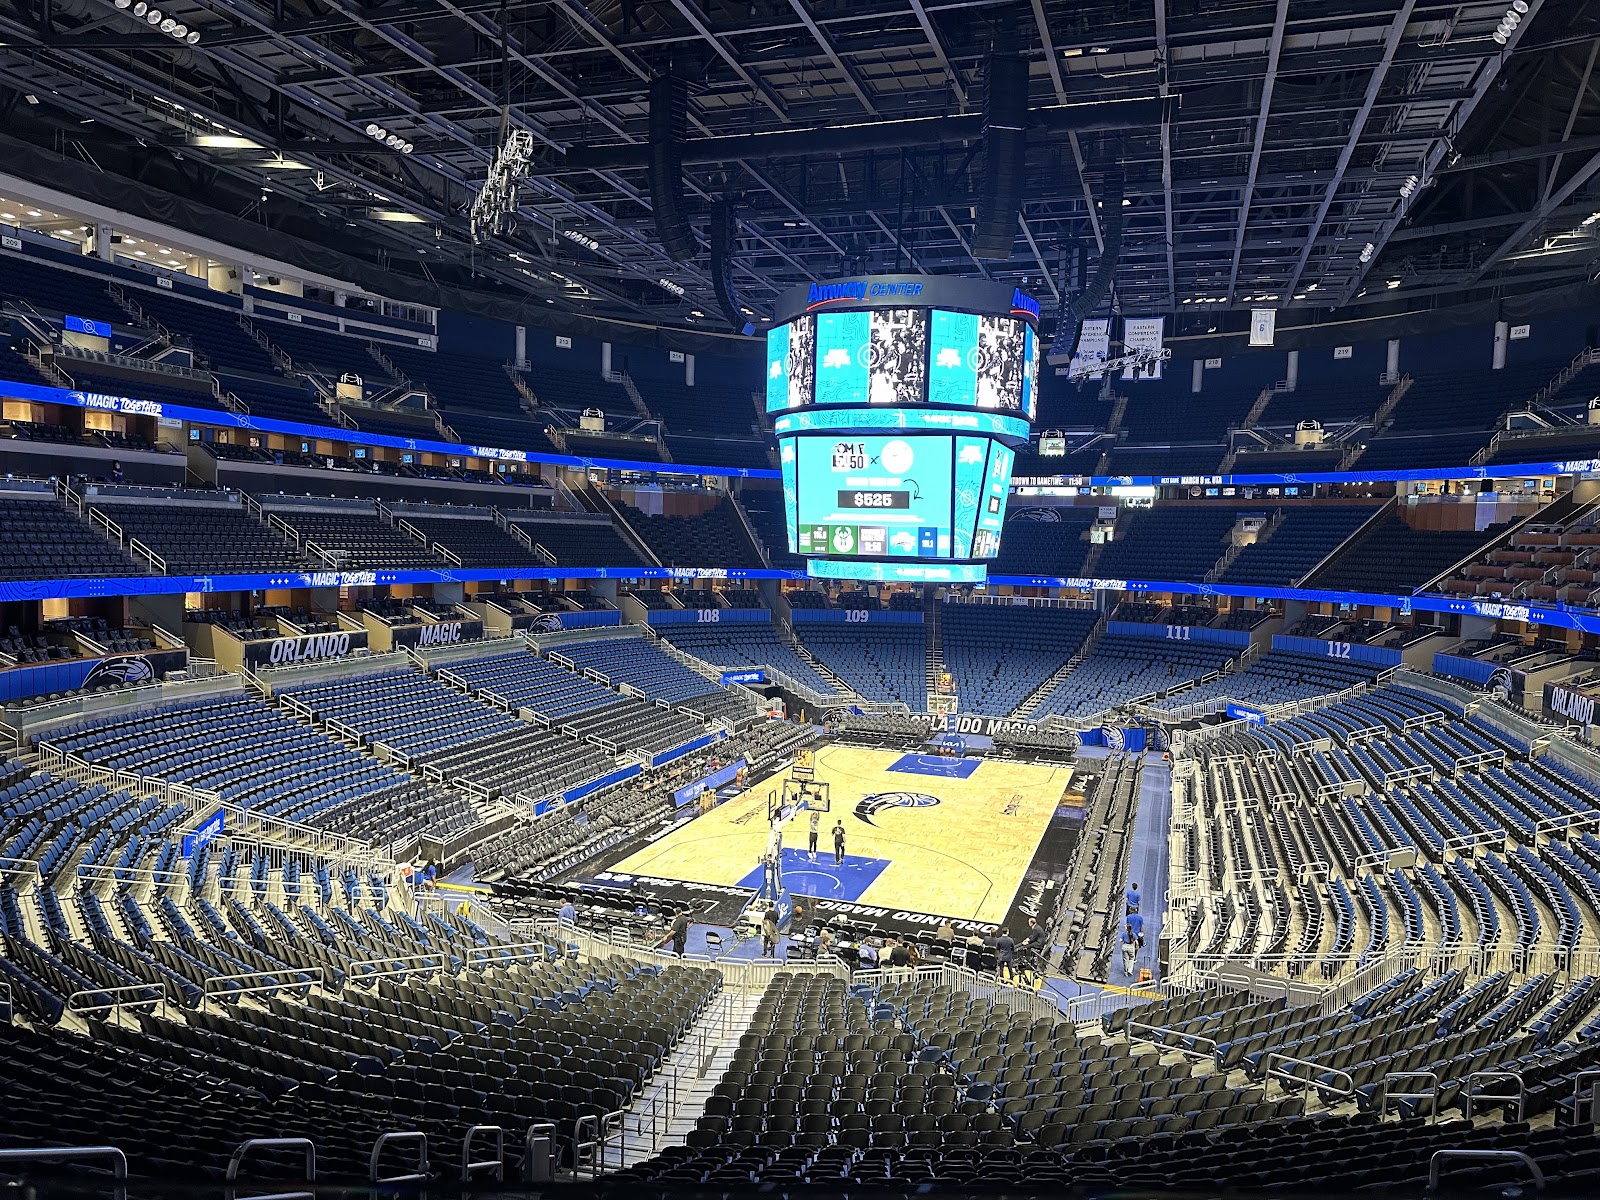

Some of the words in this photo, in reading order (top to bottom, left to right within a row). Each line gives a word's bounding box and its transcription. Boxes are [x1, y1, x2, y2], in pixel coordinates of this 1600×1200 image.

[5, 238, 18, 247] 209
[808, 281, 868, 303] Amway
[870, 283, 923, 296] CENTER
[1259, 323, 1265, 332] 6
[86, 393, 119, 409] MAGIC
[120, 397, 162, 416] TOGETHER
[477, 446, 499, 457] MAGIC
[1565, 460, 1590, 472] MAGIC
[1030, 476, 1037, 486] TO
[1181, 476, 1199, 485] MARCH
[1212, 476, 1222, 485] UTA
[854, 492, 892, 507] $525
[312, 572, 339, 586] MAGIC
[340, 570, 376, 586] TOGETHER
[674, 567, 696, 577] MAGIC
[697, 567, 728, 578] TOGETHER
[1066, 577, 1092, 587] MAGIC
[1092, 578, 1127, 590] TOGETHER
[697, 609, 719, 623] 108
[845, 609, 869, 623] 109
[1480, 602, 1502, 616] MAGIC
[1502, 604, 1530, 622] TOGETHER
[419, 622, 461, 645] MAGIC
[1166, 624, 1190, 641] 111
[269, 633, 350, 663] ORLANDO
[1327, 640, 1350, 659] 112
[1551, 686, 1595, 725] ORLANDO
[815, 900, 890, 918] MAGIC
